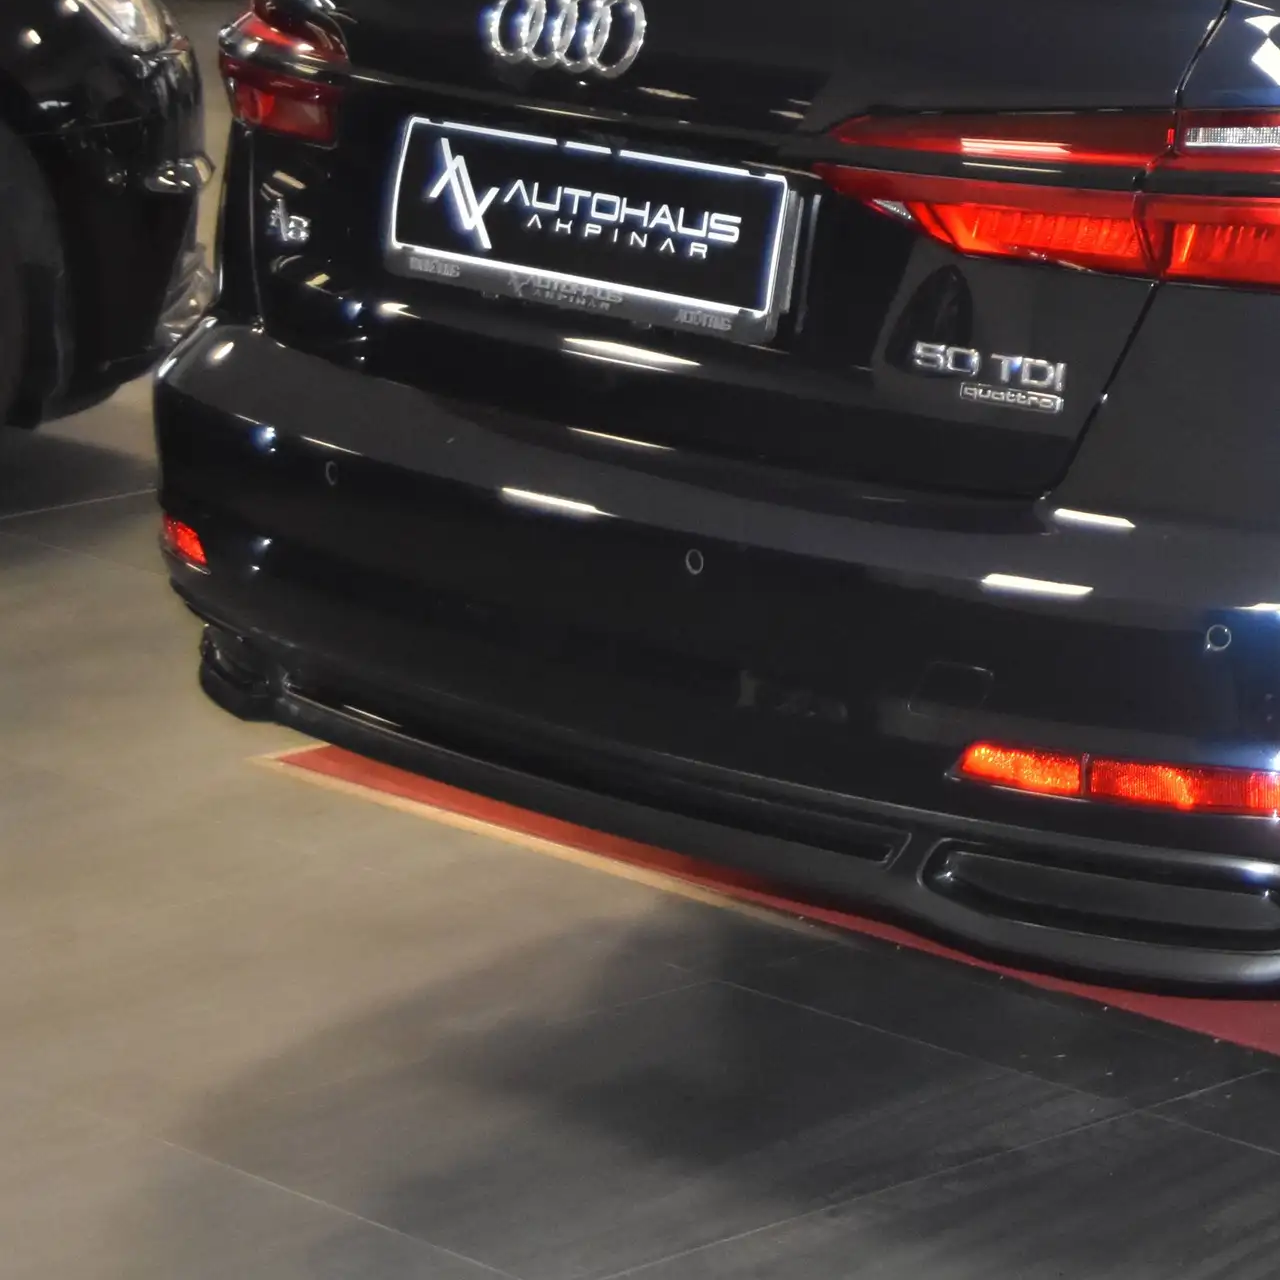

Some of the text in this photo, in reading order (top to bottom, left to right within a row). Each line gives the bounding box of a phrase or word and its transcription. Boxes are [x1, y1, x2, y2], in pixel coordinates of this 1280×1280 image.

[503, 179, 742, 243] AUTOHAUS
[526, 214, 708, 259] AKPINAR
[914, 340, 1067, 393] 50 TDI
[963, 386, 1055, 410] quattro
